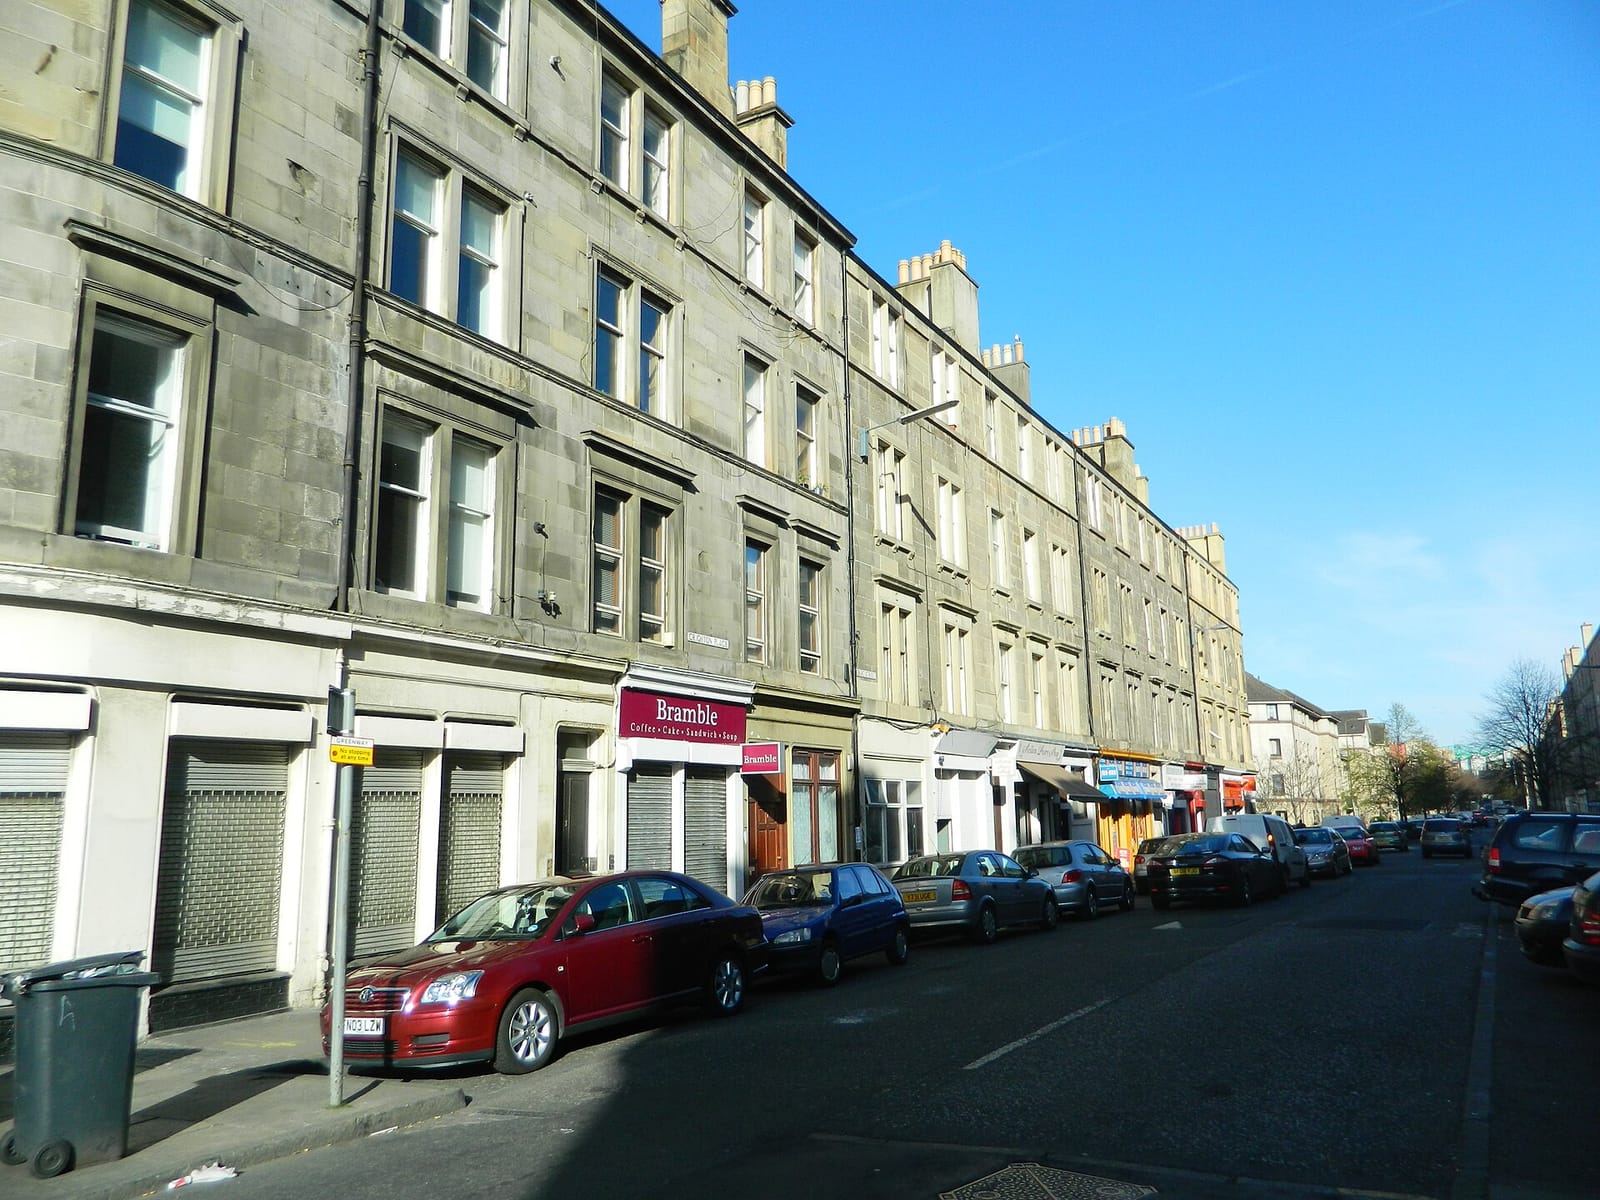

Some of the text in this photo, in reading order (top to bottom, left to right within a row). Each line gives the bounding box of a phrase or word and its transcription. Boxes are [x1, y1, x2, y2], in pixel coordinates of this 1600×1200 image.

[656, 698, 718, 726] Bramble
[630, 722, 738, 742] Coffee Cake Sandwich Soup
[348, 749, 370, 757] stopping
[743, 754, 777, 764] Bramble
[364, 1019, 382, 1031] LZW
